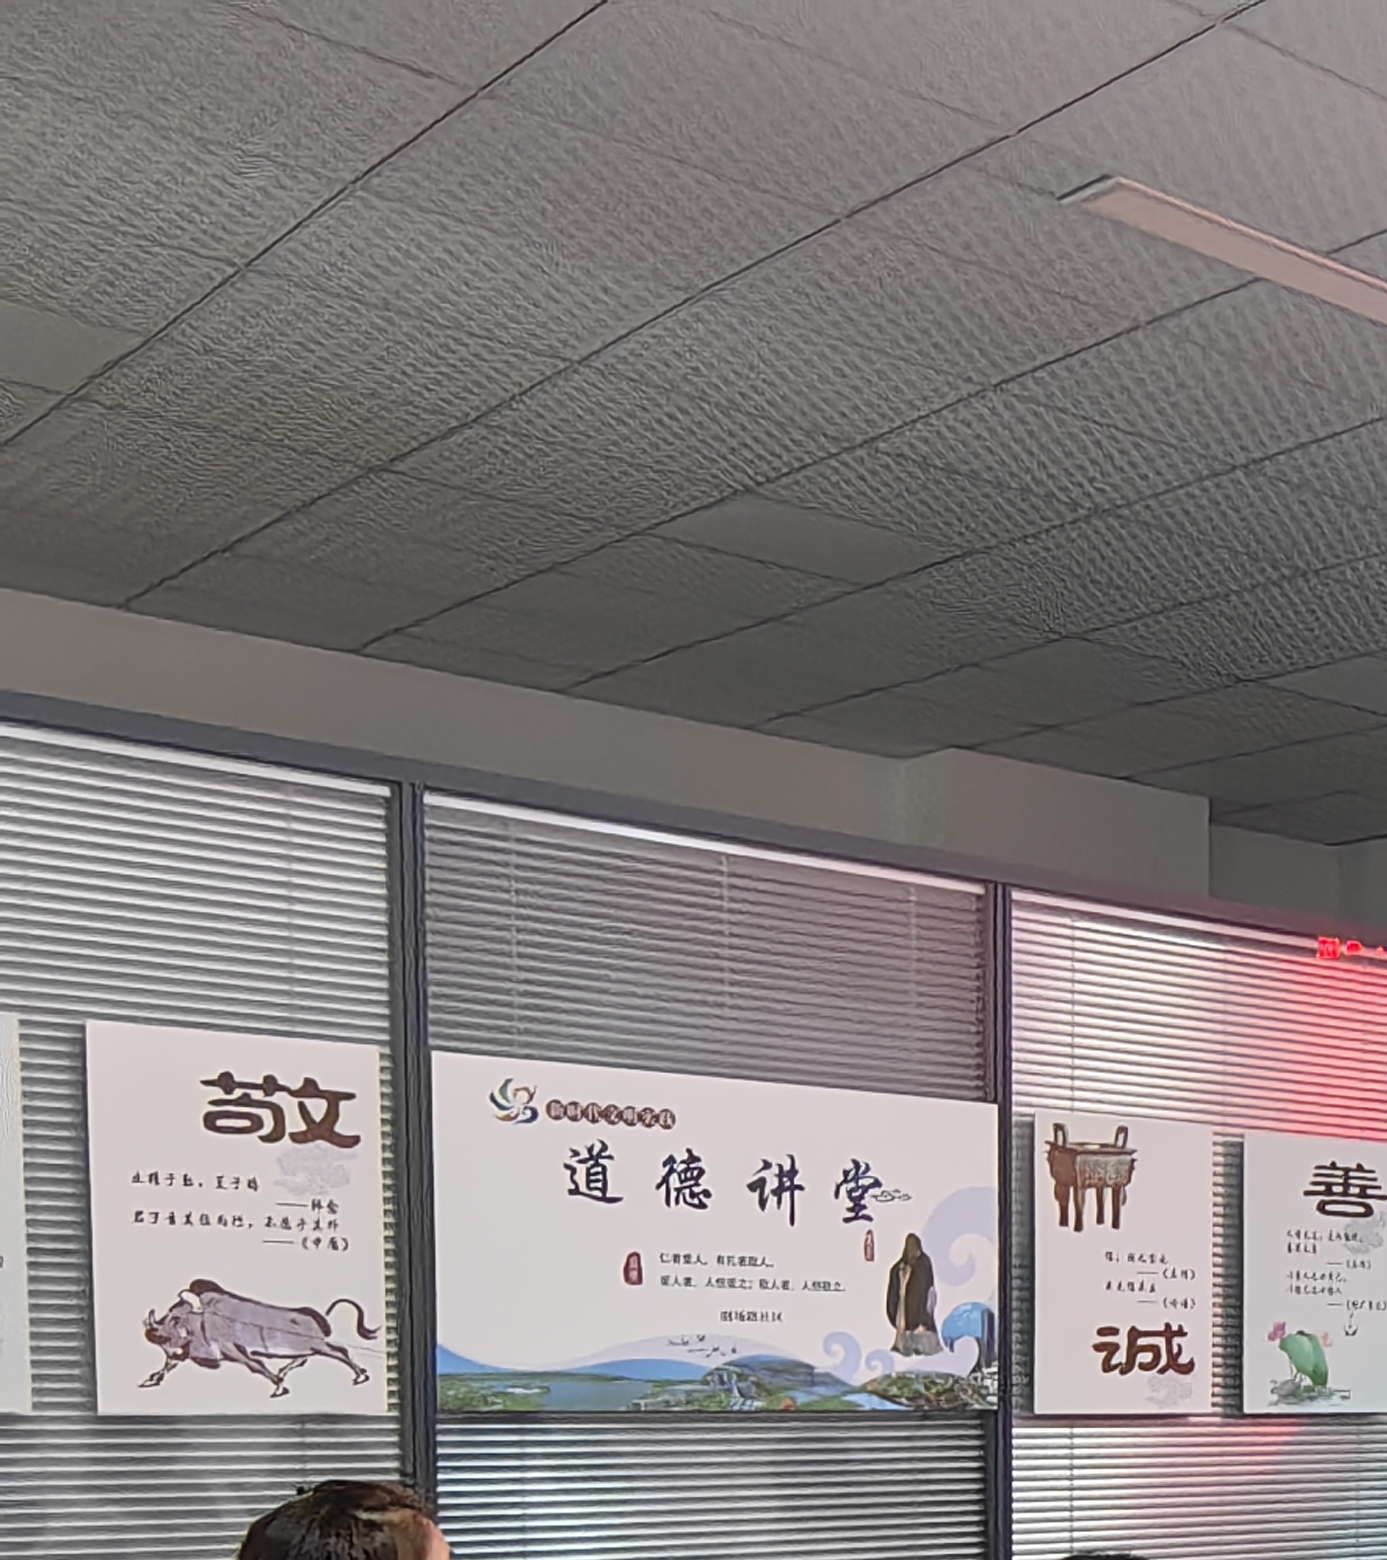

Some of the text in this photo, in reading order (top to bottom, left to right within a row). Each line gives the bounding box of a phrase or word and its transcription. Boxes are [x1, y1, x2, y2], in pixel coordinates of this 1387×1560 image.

[563, 1138, 884, 1227] 道德讲堂
[1092, 1322, 1195, 1376] 诚
